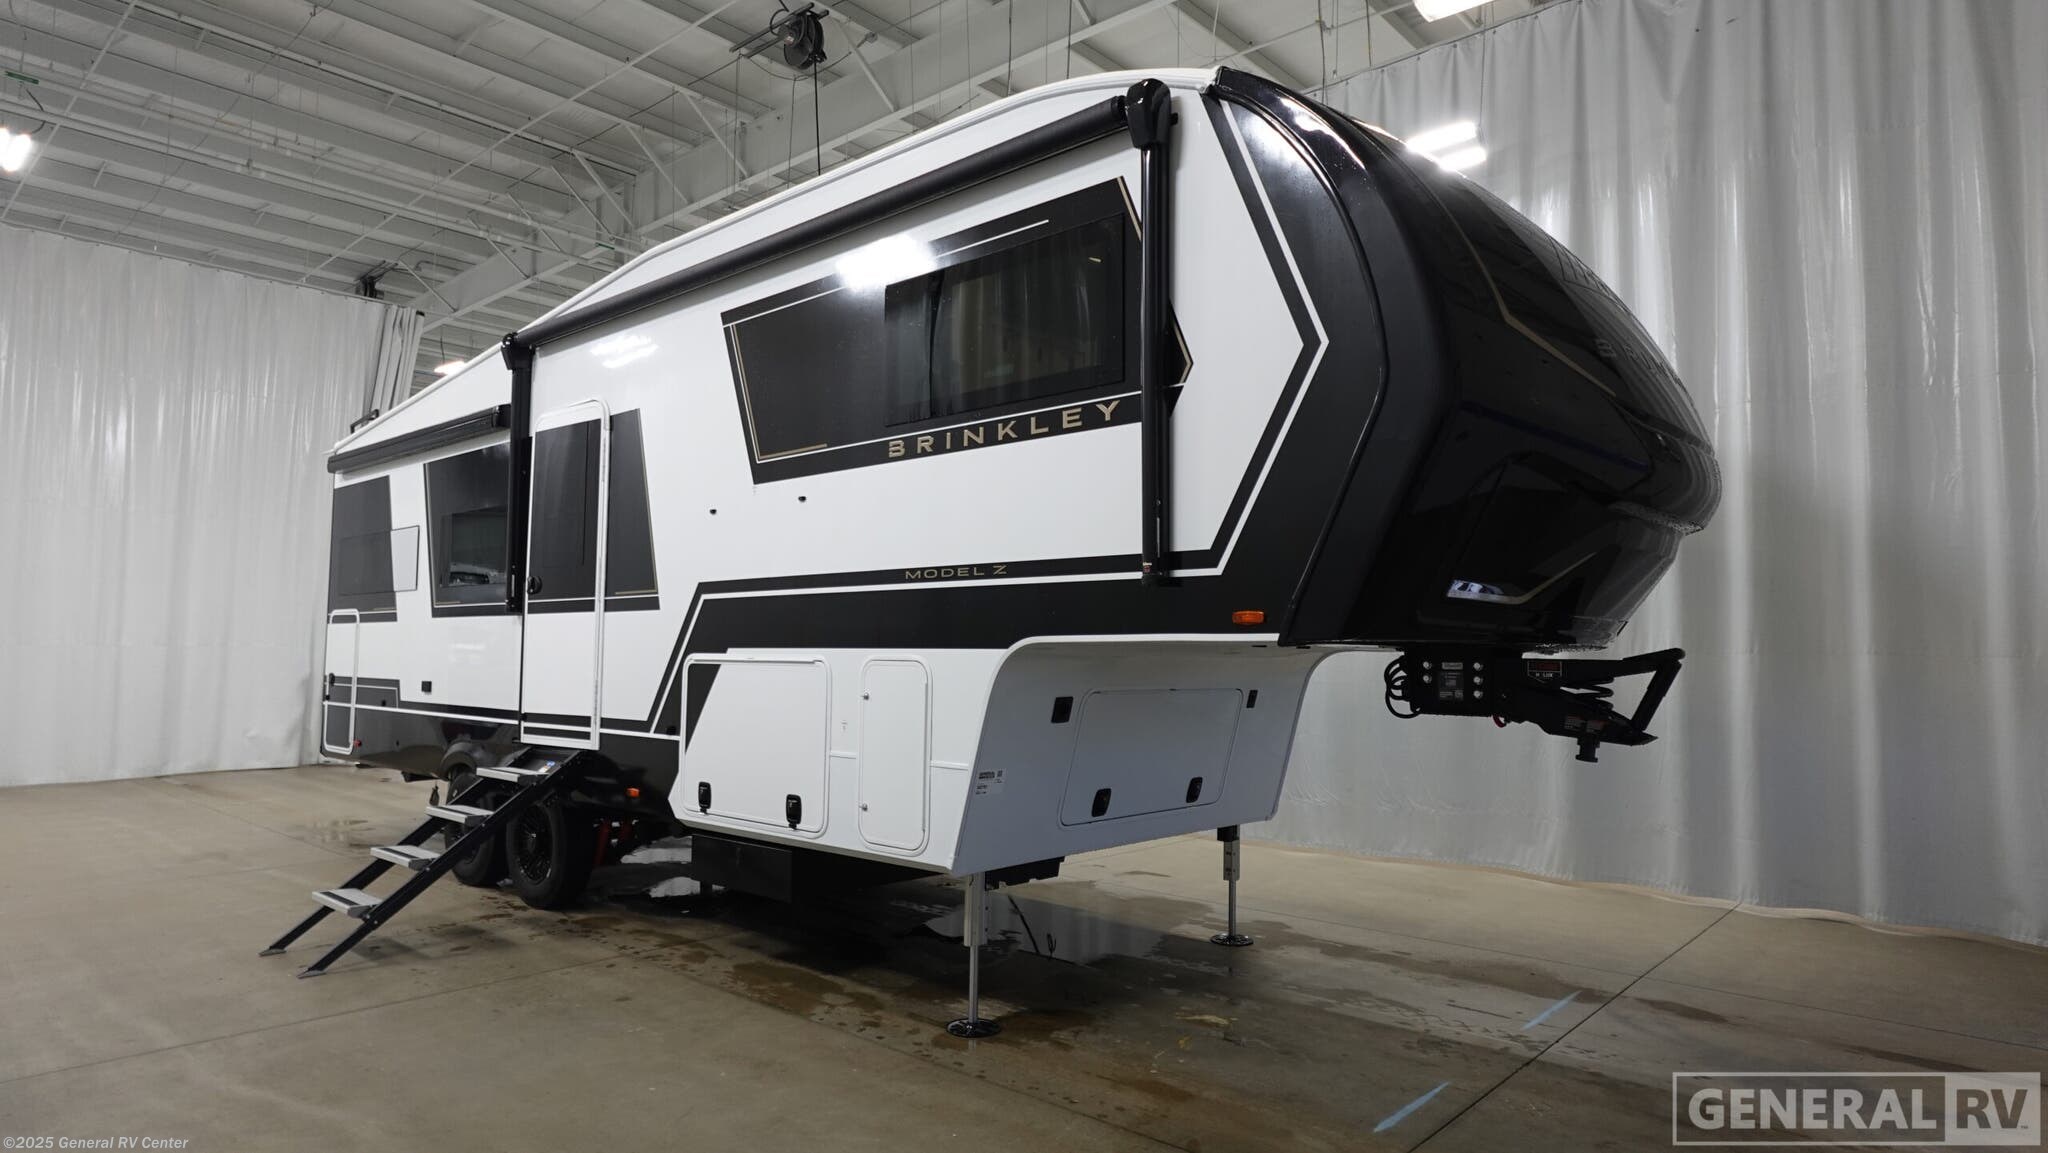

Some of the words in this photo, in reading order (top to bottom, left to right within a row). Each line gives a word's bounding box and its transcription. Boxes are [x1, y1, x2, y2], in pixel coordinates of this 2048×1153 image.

[888, 400, 1120, 459] BRINKLEY
[905, 566, 985, 580] MODEL
[992, 563, 1008, 576] Z
